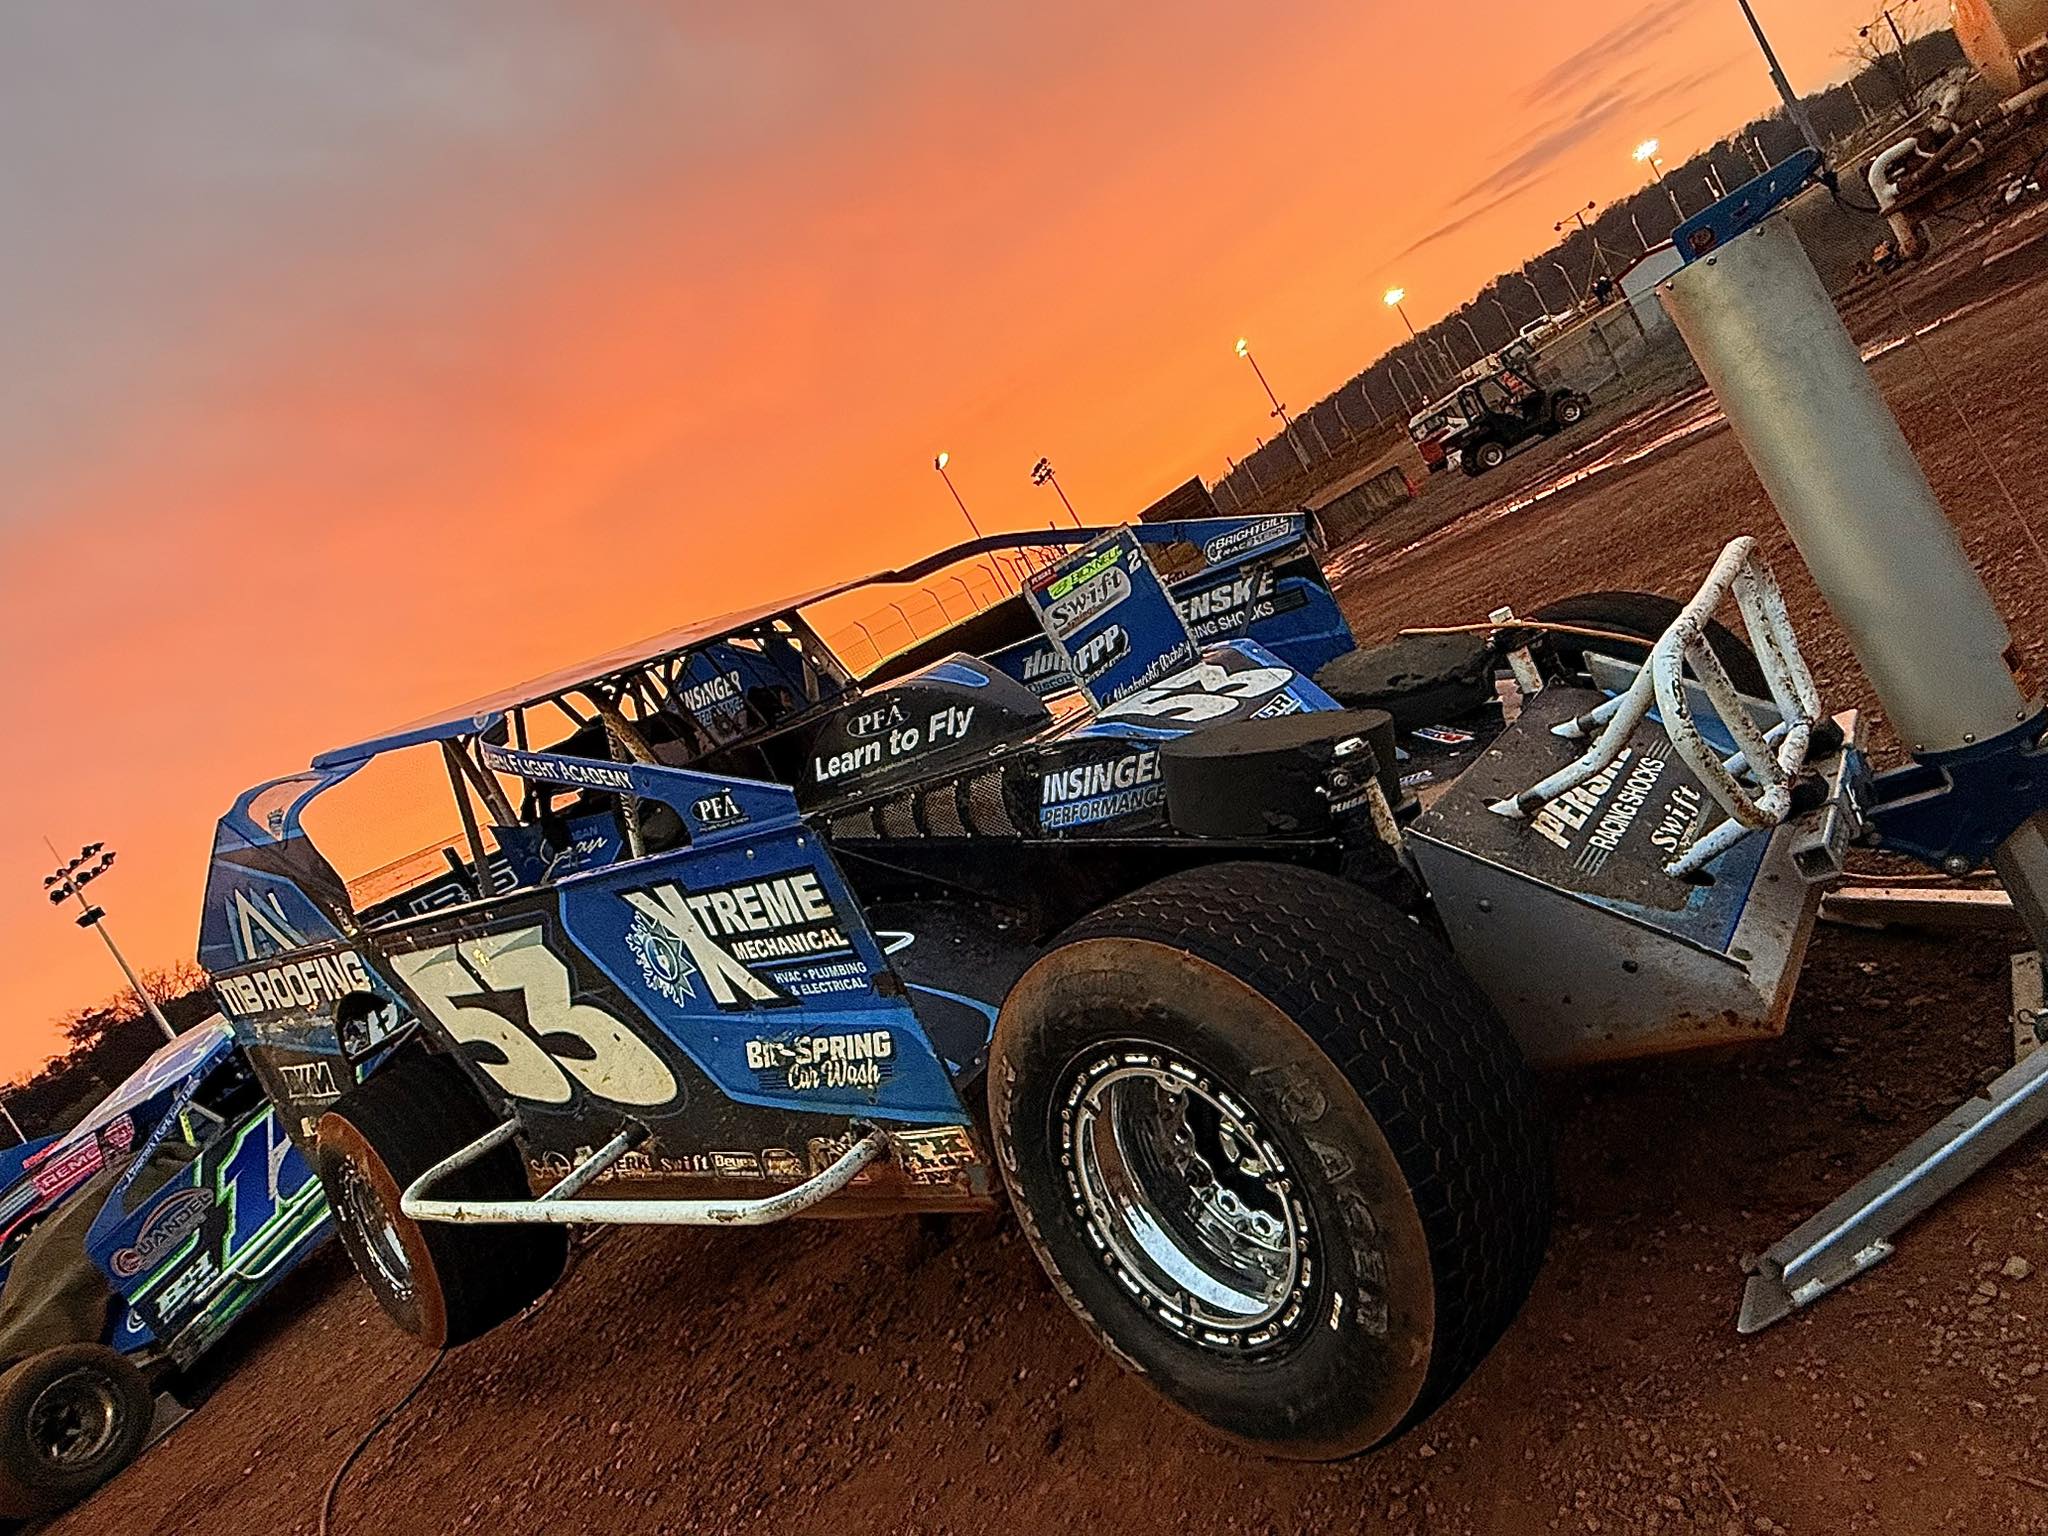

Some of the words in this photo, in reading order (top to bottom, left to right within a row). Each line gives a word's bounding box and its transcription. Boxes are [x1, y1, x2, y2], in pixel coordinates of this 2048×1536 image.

[1215, 517, 1289, 551] BRIGHTBILL
[1126, 550, 1142, 574] 2
[1052, 570, 1122, 629] Swift
[1219, 601, 1275, 631] SHOKS
[1075, 624, 1121, 673] FPP
[1158, 640, 1192, 674] Archery
[1097, 662, 1294, 722] 53
[858, 704, 904, 735] PFA
[815, 739, 881, 783] Learn
[889, 727, 920, 753] to
[928, 705, 975, 743] Fly
[506, 753, 560, 779] FLIGHT
[559, 760, 634, 789] ACADEMY
[697, 789, 742, 821] PFA
[1590, 797, 1637, 852] RACING
[1617, 756, 1666, 813] SHOCKS
[1650, 785, 1701, 853] Swift
[622, 872, 835, 1005] XTREME
[731, 926, 850, 961] MECHANICAL
[252, 950, 372, 1010] ROOFING
[774, 970, 802, 985] HVAC
[808, 961, 868, 980] PLUMBING
[790, 983, 800, 995] &
[801, 976, 868, 995] ELECTRICAL
[388, 925, 678, 1106] 53
[794, 1030, 892, 1066] SPRING
[788, 1062, 821, 1091] Car
[821, 1056, 881, 1090] Wash
